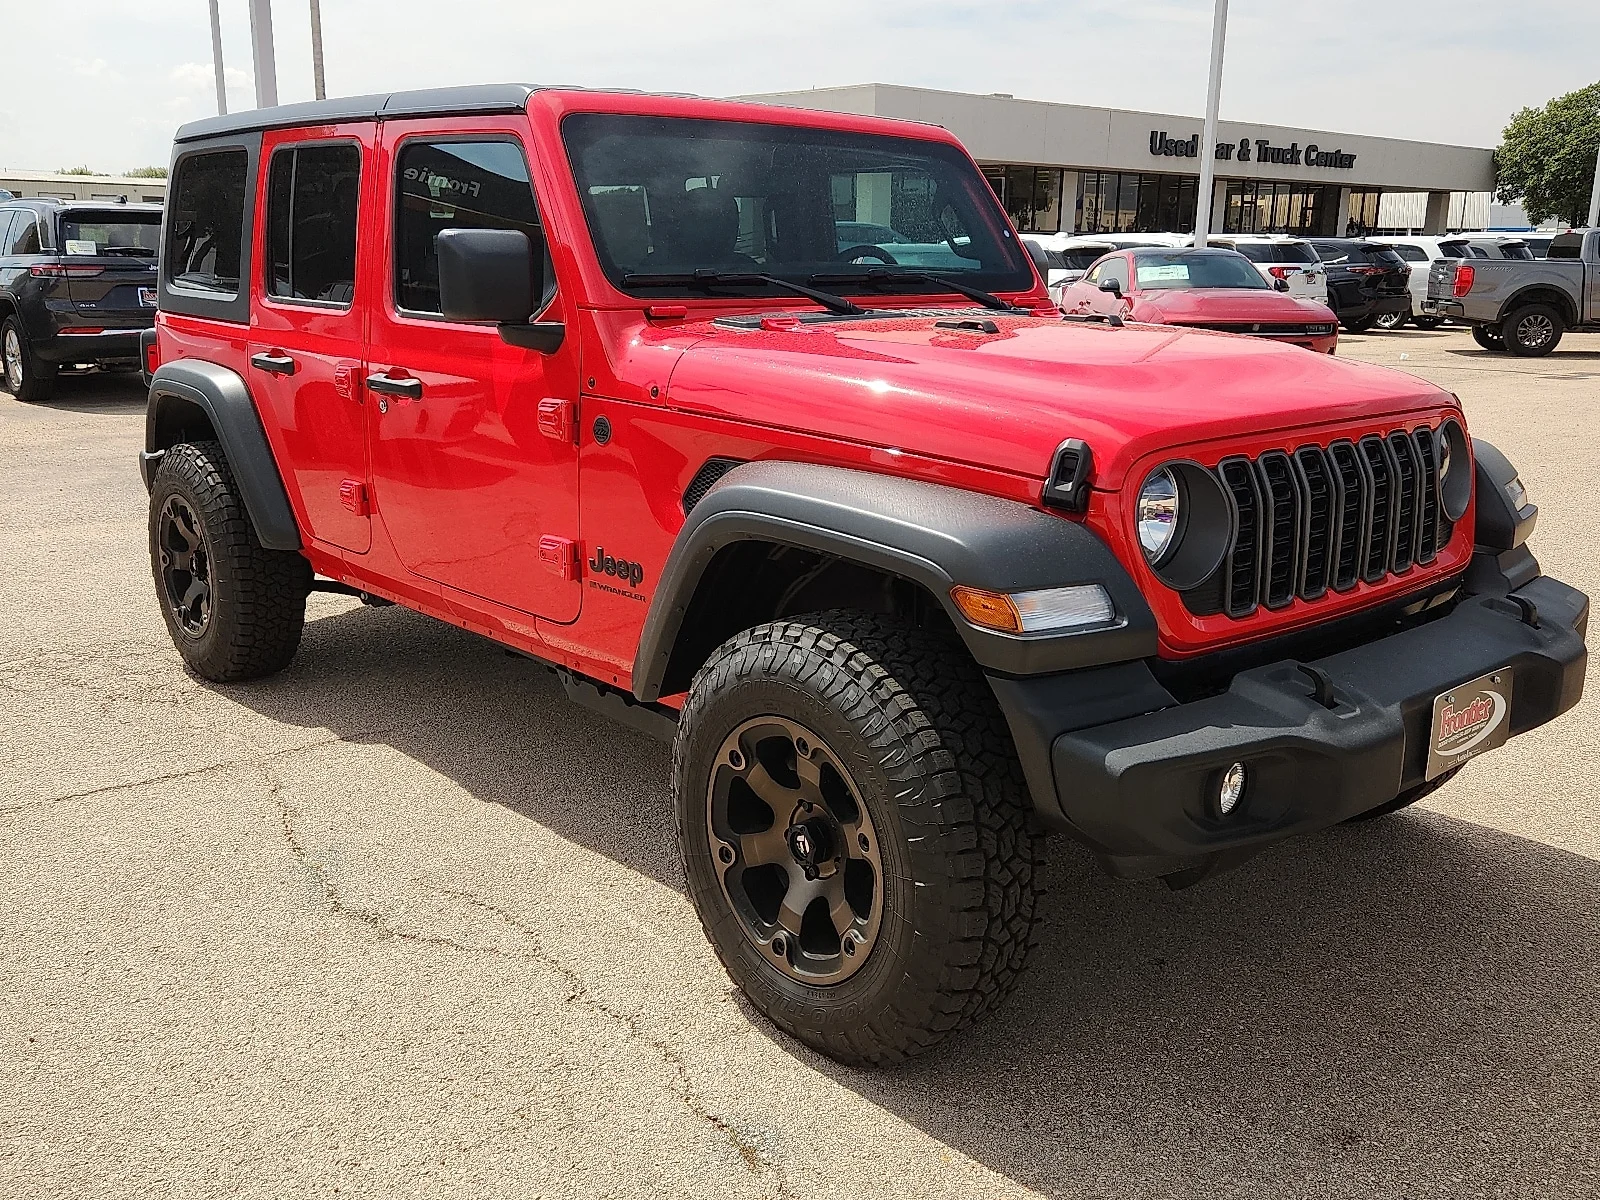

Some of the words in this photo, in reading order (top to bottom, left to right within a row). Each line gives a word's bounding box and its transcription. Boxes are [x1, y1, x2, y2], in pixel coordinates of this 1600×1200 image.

[1150, 131, 1199, 157] Used
[1214, 138, 1235, 161] ar
[1237, 138, 1251, 161] &
[1255, 139, 1302, 165] Truck
[1305, 145, 1356, 169] Center
[588, 545, 644, 588] Jeep
[597, 582, 647, 603] WRANGLER
[1438, 697, 1493, 742] Frontier
